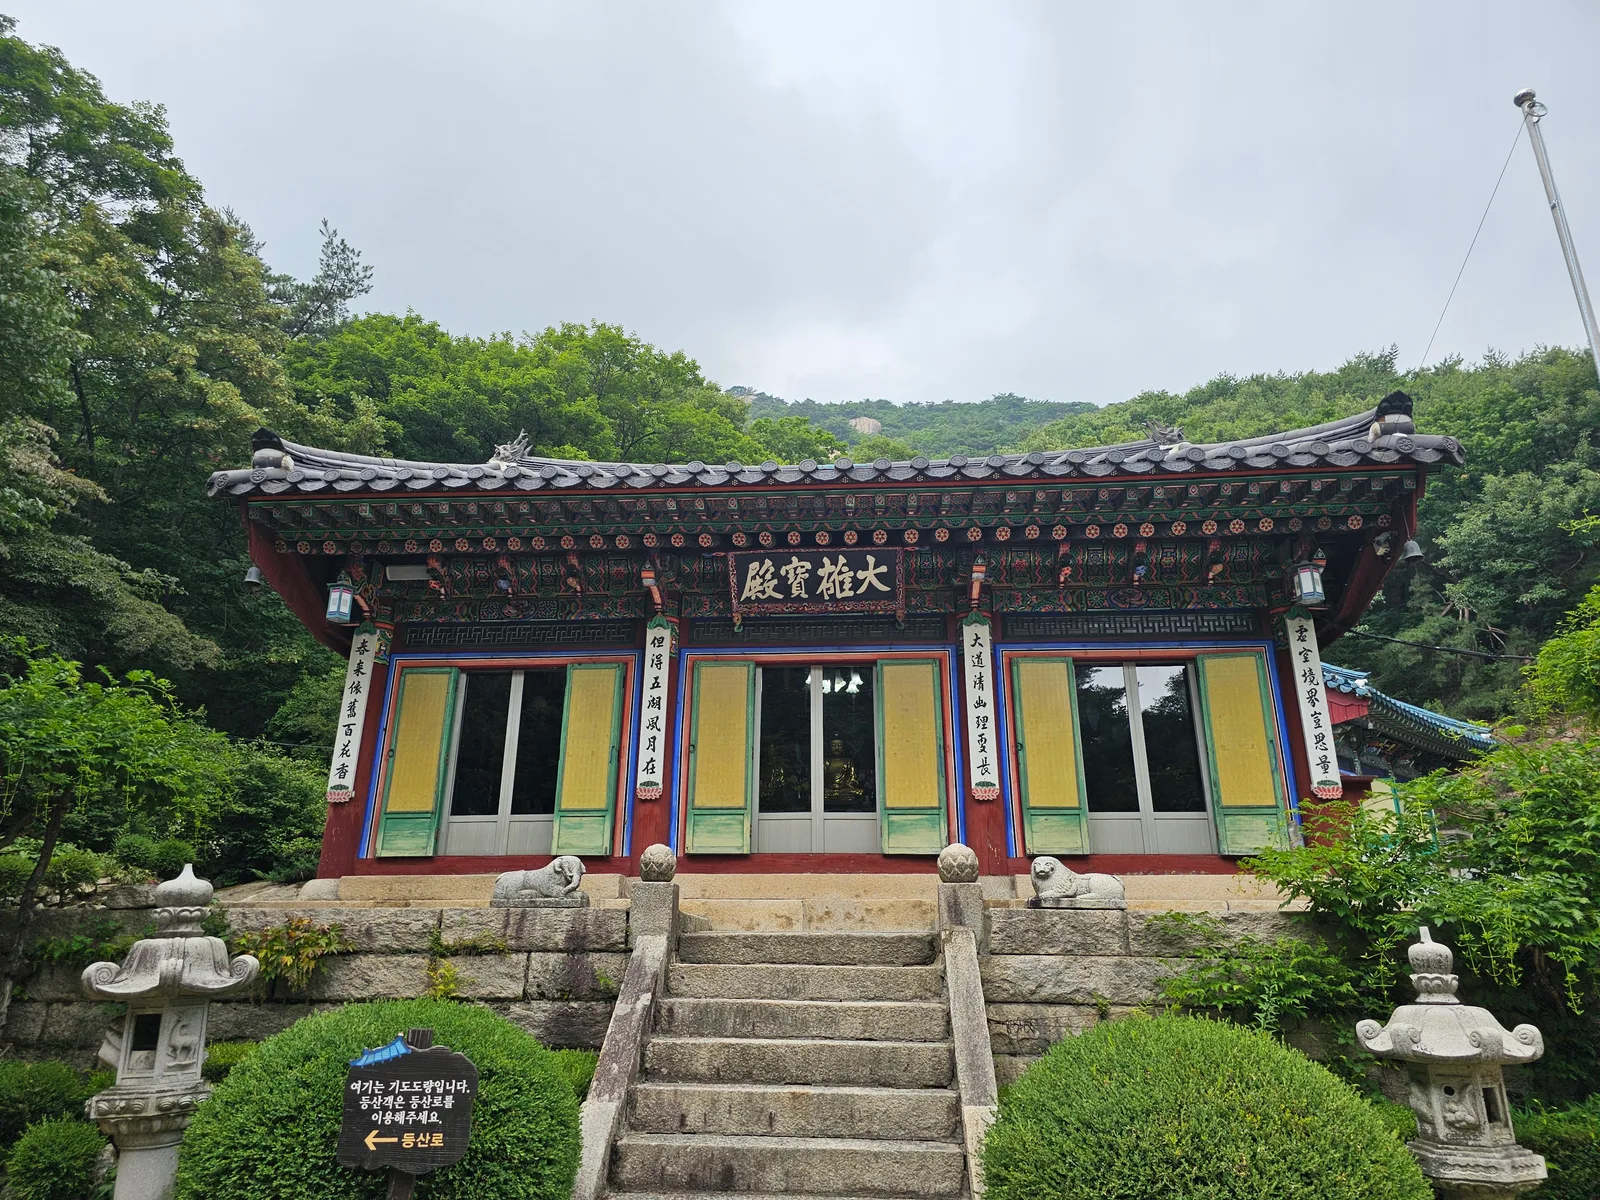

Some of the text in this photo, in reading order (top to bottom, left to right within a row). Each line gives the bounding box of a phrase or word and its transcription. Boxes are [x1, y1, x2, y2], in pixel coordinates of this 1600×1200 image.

[740, 554, 891, 601] 大雄寶殿
[350, 1079, 470, 1094] 여기는 기도도량입니다.
[359, 1095, 455, 1109] 등산객은 등산로를
[371, 1110, 443, 1125] 이용해주세요.
[401, 1132, 444, 1148] 등산로
